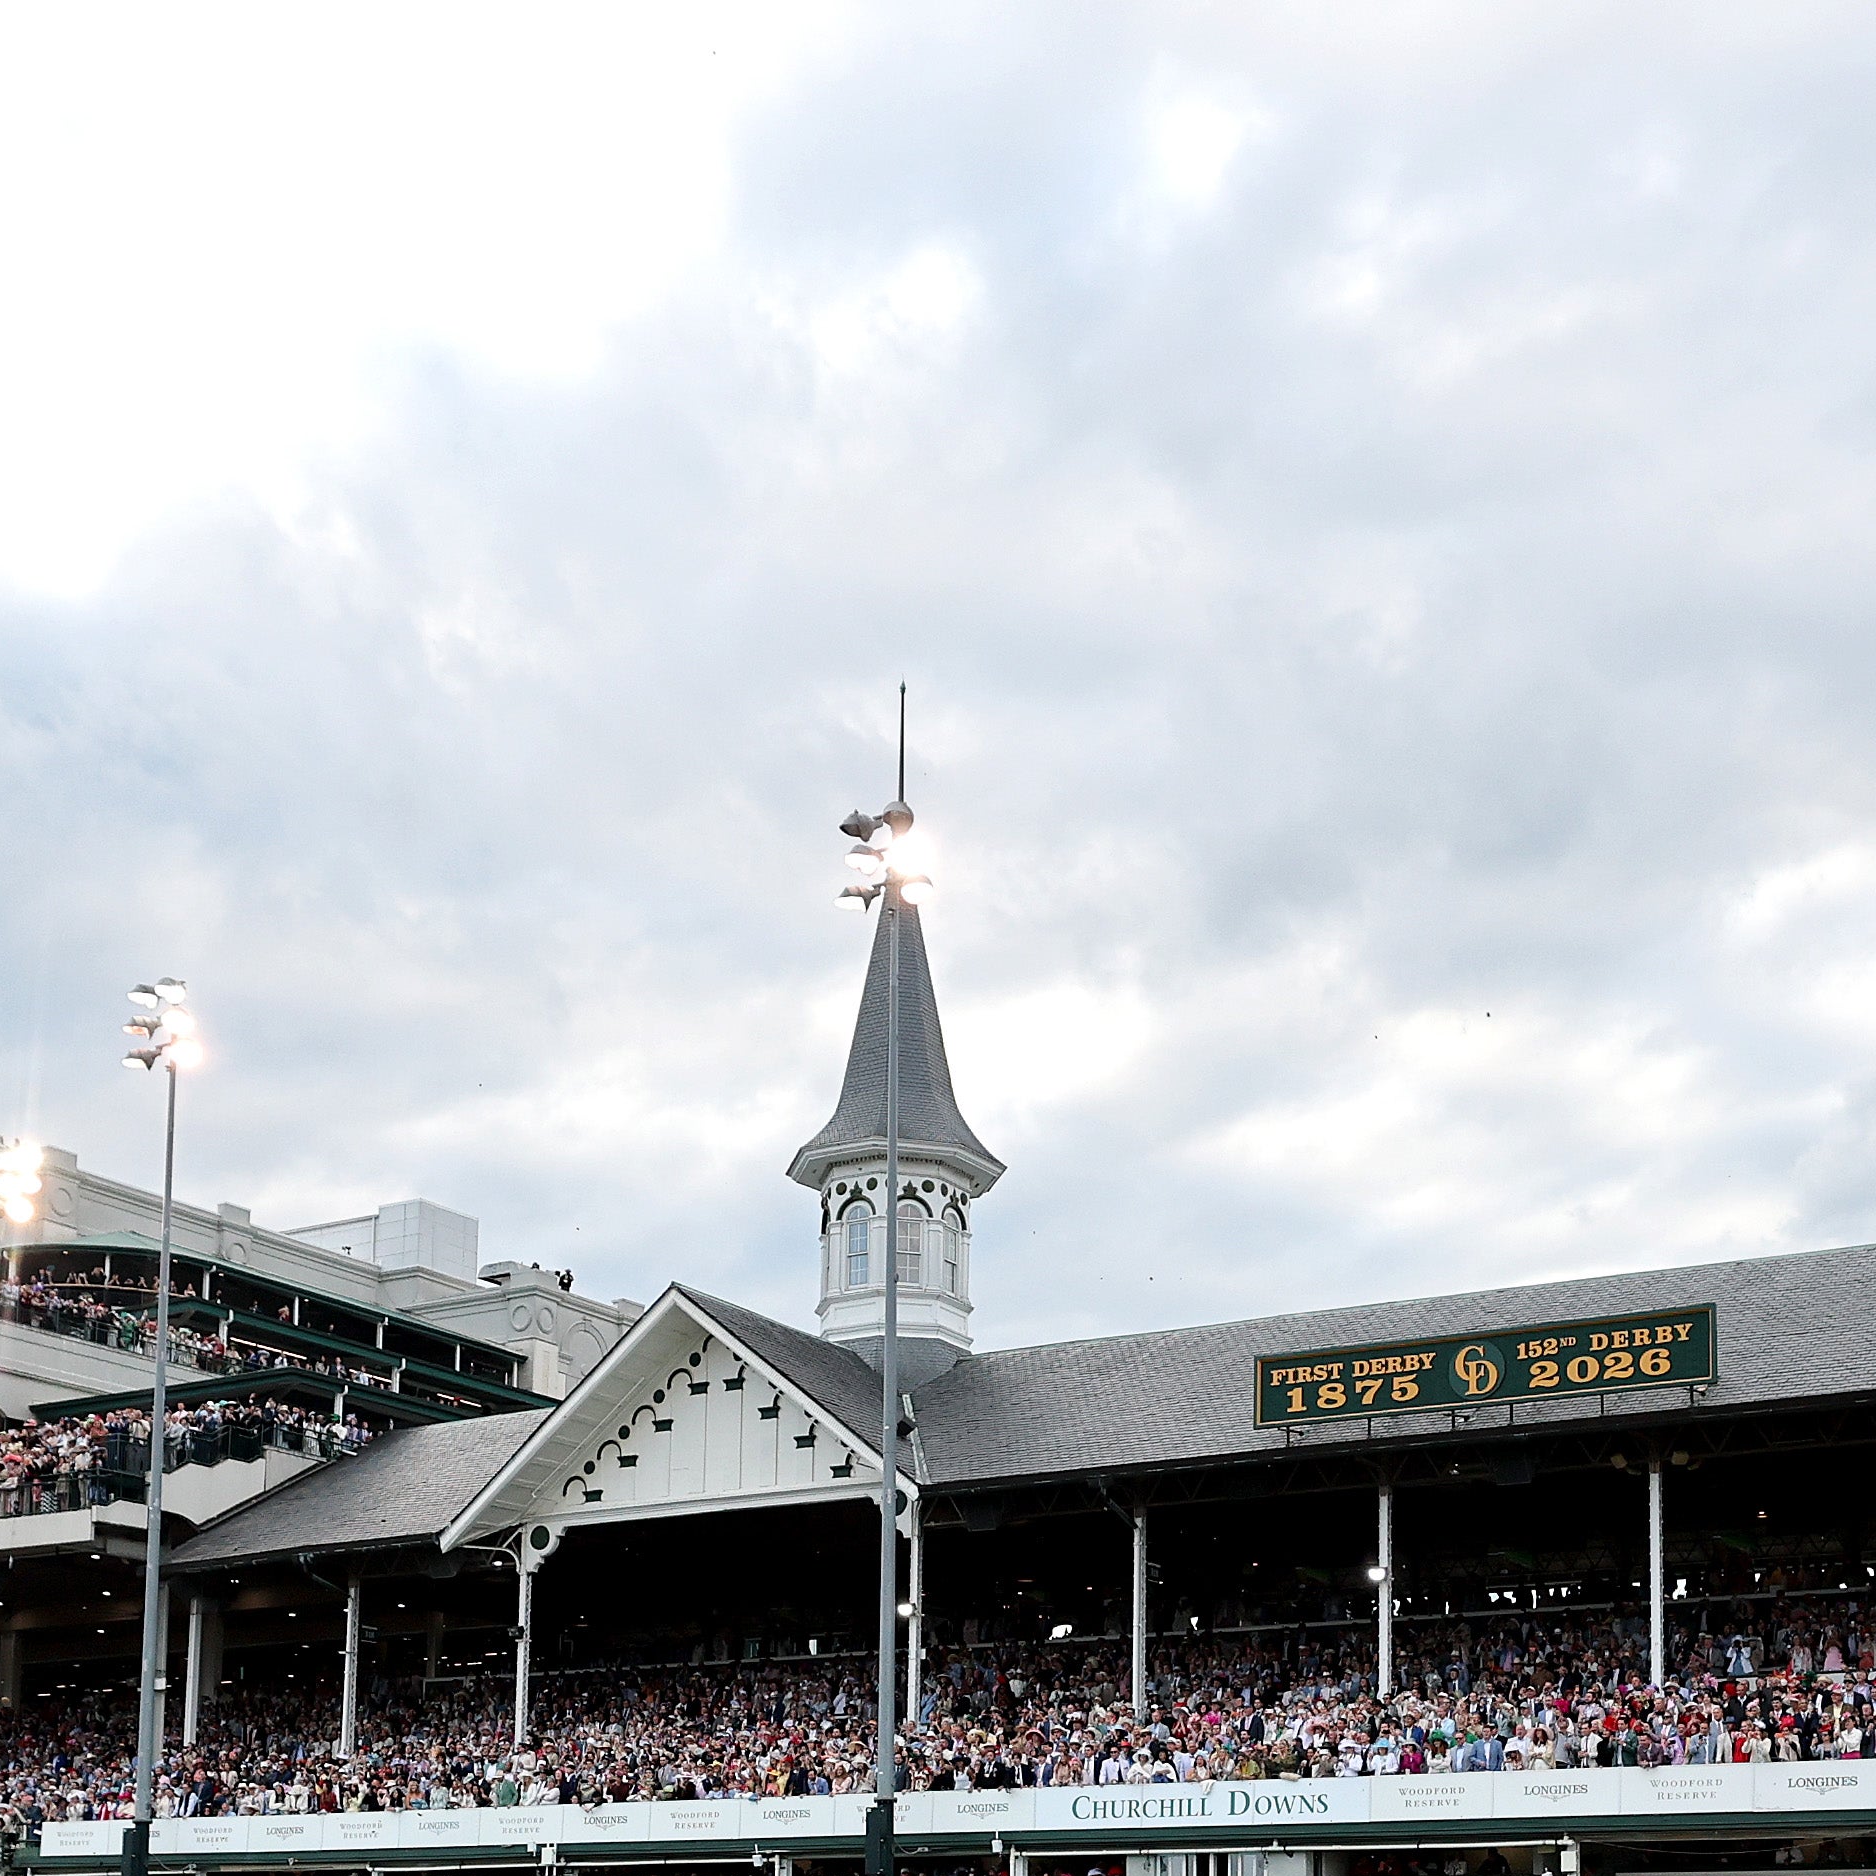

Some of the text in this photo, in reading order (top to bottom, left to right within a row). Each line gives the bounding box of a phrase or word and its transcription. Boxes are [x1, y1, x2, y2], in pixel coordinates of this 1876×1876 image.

[1516, 1323, 1693, 1361] 152ND DERBY
[1270, 1352, 1436, 1387] FIRST DERBY
[1528, 1348, 1672, 1389] 2026
[1286, 1373, 1421, 1413] 1875
[1650, 1778, 1724, 1789] WOODFORD
[1787, 1776, 1859, 1789] LONGINES
[1398, 1786, 1466, 1796] WOODFORD
[1523, 1784, 1589, 1796] LONGINES
[1657, 1791, 1718, 1801] RESERVE
[957, 1803, 1009, 1814] LONGINES
[1071, 1790, 1329, 1820] CHURCHILL DOWNS
[1405, 1799, 1460, 1808] RESERVE
[670, 1811, 721, 1819] WOODFORD
[762, 1809, 811, 1820] LONGINES
[498, 1817, 545, 1825] WOODFORD
[583, 1815, 628, 1825] LONGINES
[266, 1826, 304, 1835] LONGINES
[339, 1822, 383, 1830] WOODFORD
[418, 1821, 460, 1831] LONGINES
[502, 1826, 541, 1834] RESERVE
[674, 1821, 716, 1830] RESERVE
[193, 1827, 233, 1835] WOODFORD
